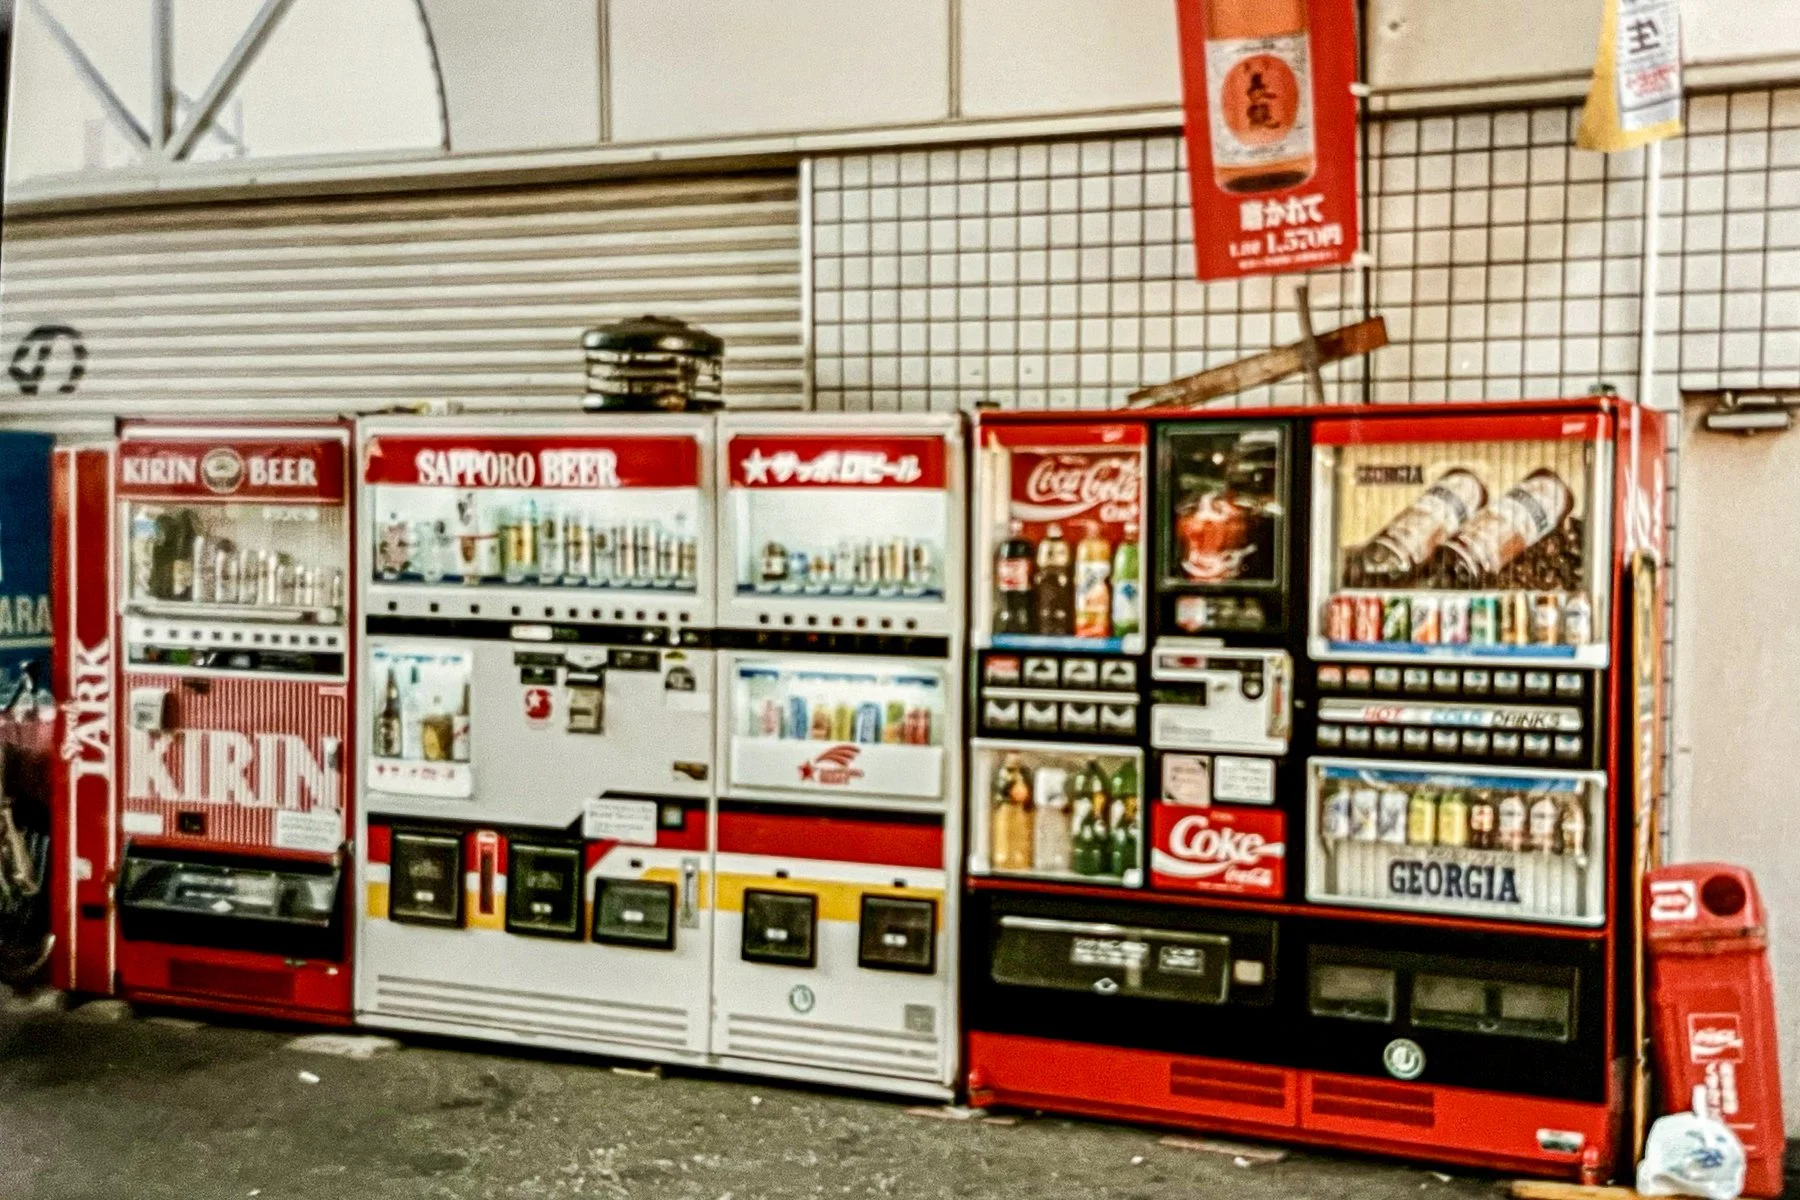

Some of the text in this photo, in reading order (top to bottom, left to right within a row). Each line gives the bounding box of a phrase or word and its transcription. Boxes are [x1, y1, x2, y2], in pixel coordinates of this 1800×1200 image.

[123, 457, 318, 486] KIRIN BEER
[416, 449, 618, 487] SAPPORO BEER
[127, 730, 342, 811] KIRIN
[1168, 814, 1266, 865] Coke
[1389, 861, 1521, 903] GEORGIA
